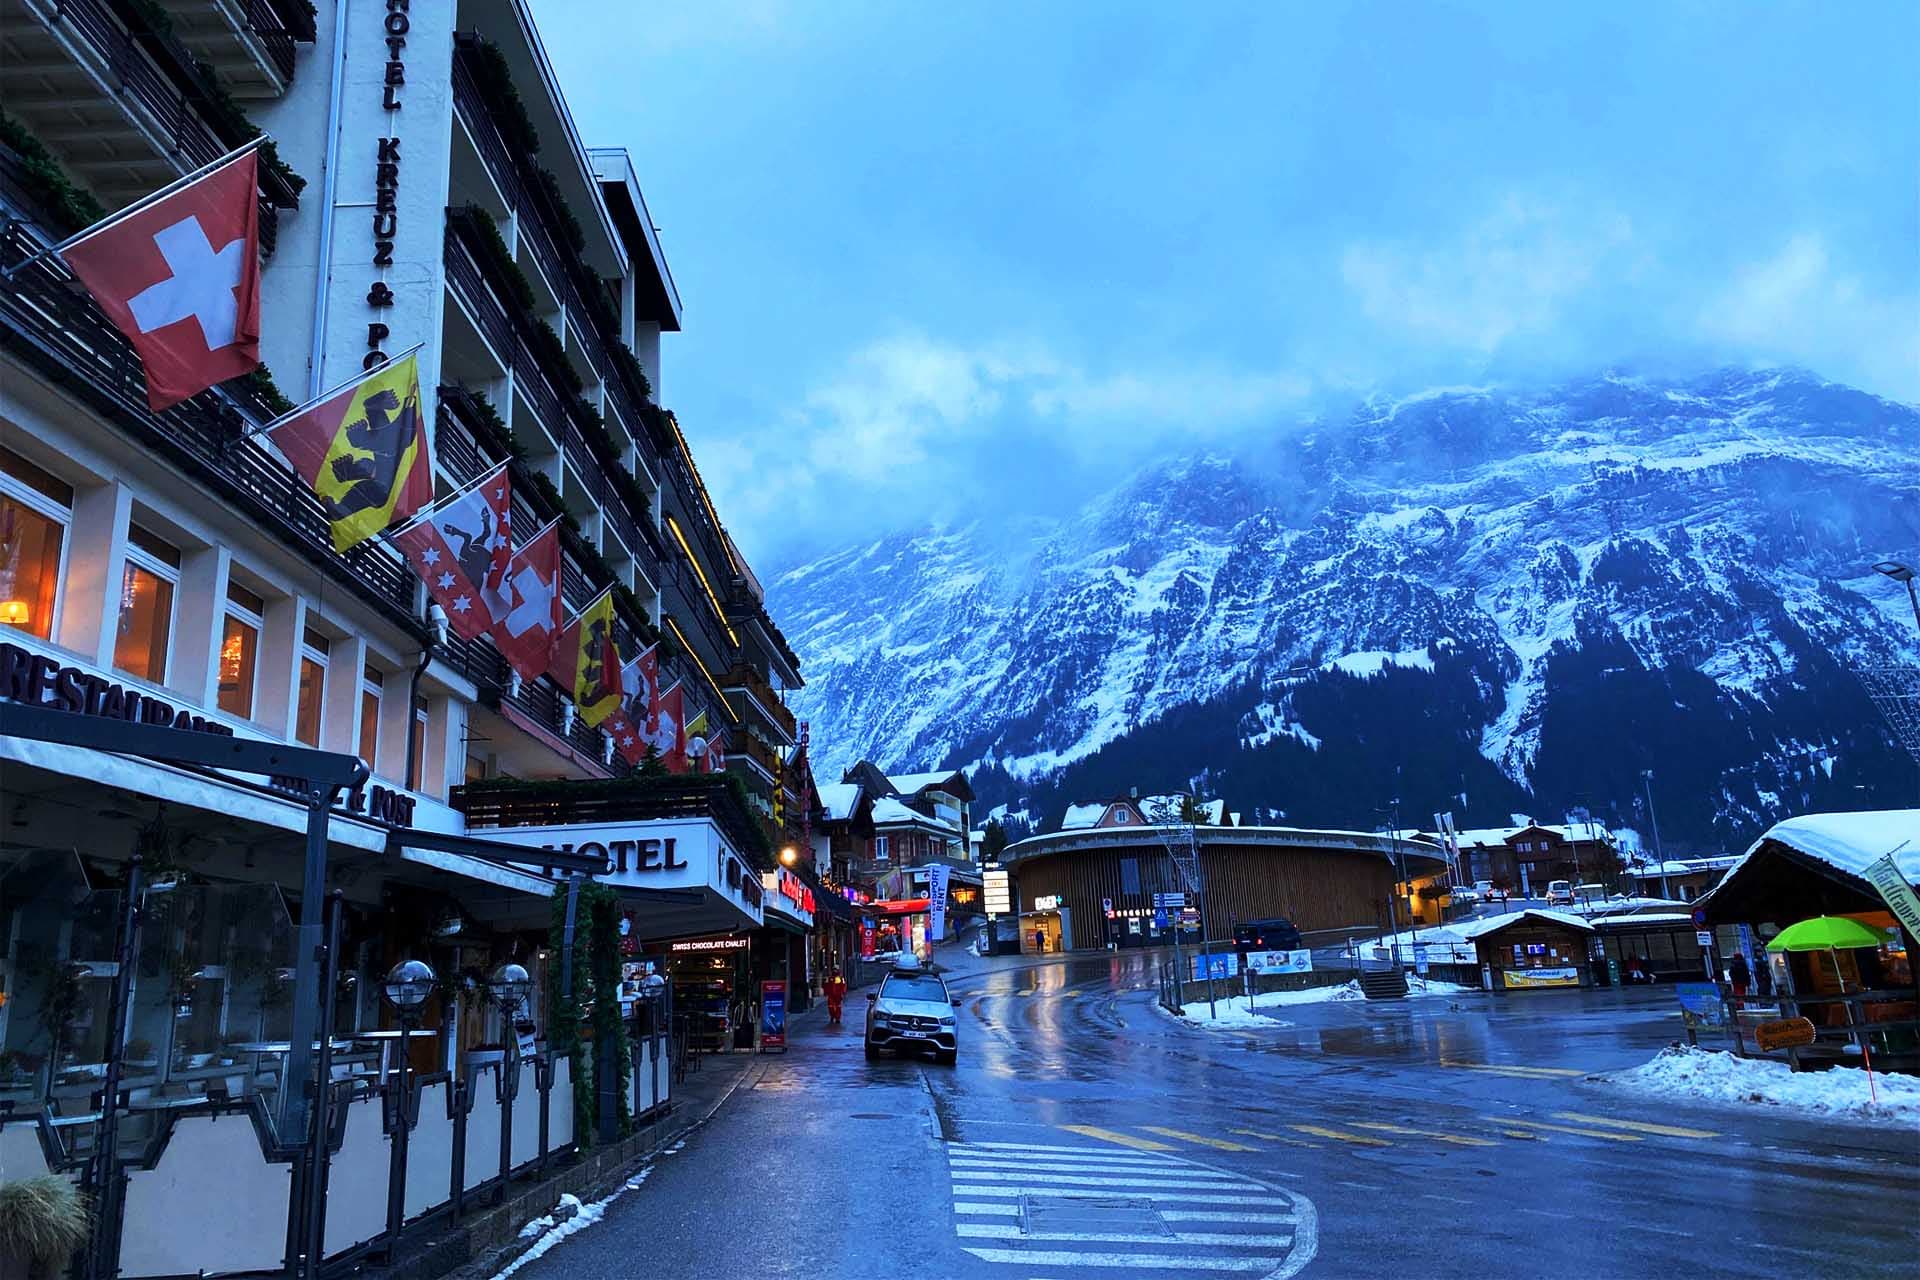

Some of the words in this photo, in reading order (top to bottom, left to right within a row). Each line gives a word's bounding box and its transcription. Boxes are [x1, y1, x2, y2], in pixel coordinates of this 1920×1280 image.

[373, 137, 401, 266] KREUZ
[366, 282, 394, 306] &
[0, 643, 233, 737] RESTAURA
[372, 785, 416, 827] POST
[936, 888, 946, 912] RENT
[672, 943, 691, 951] SWISS
[691, 941, 725, 950] CHOCOLATE
[725, 939, 747, 948] CHALET
